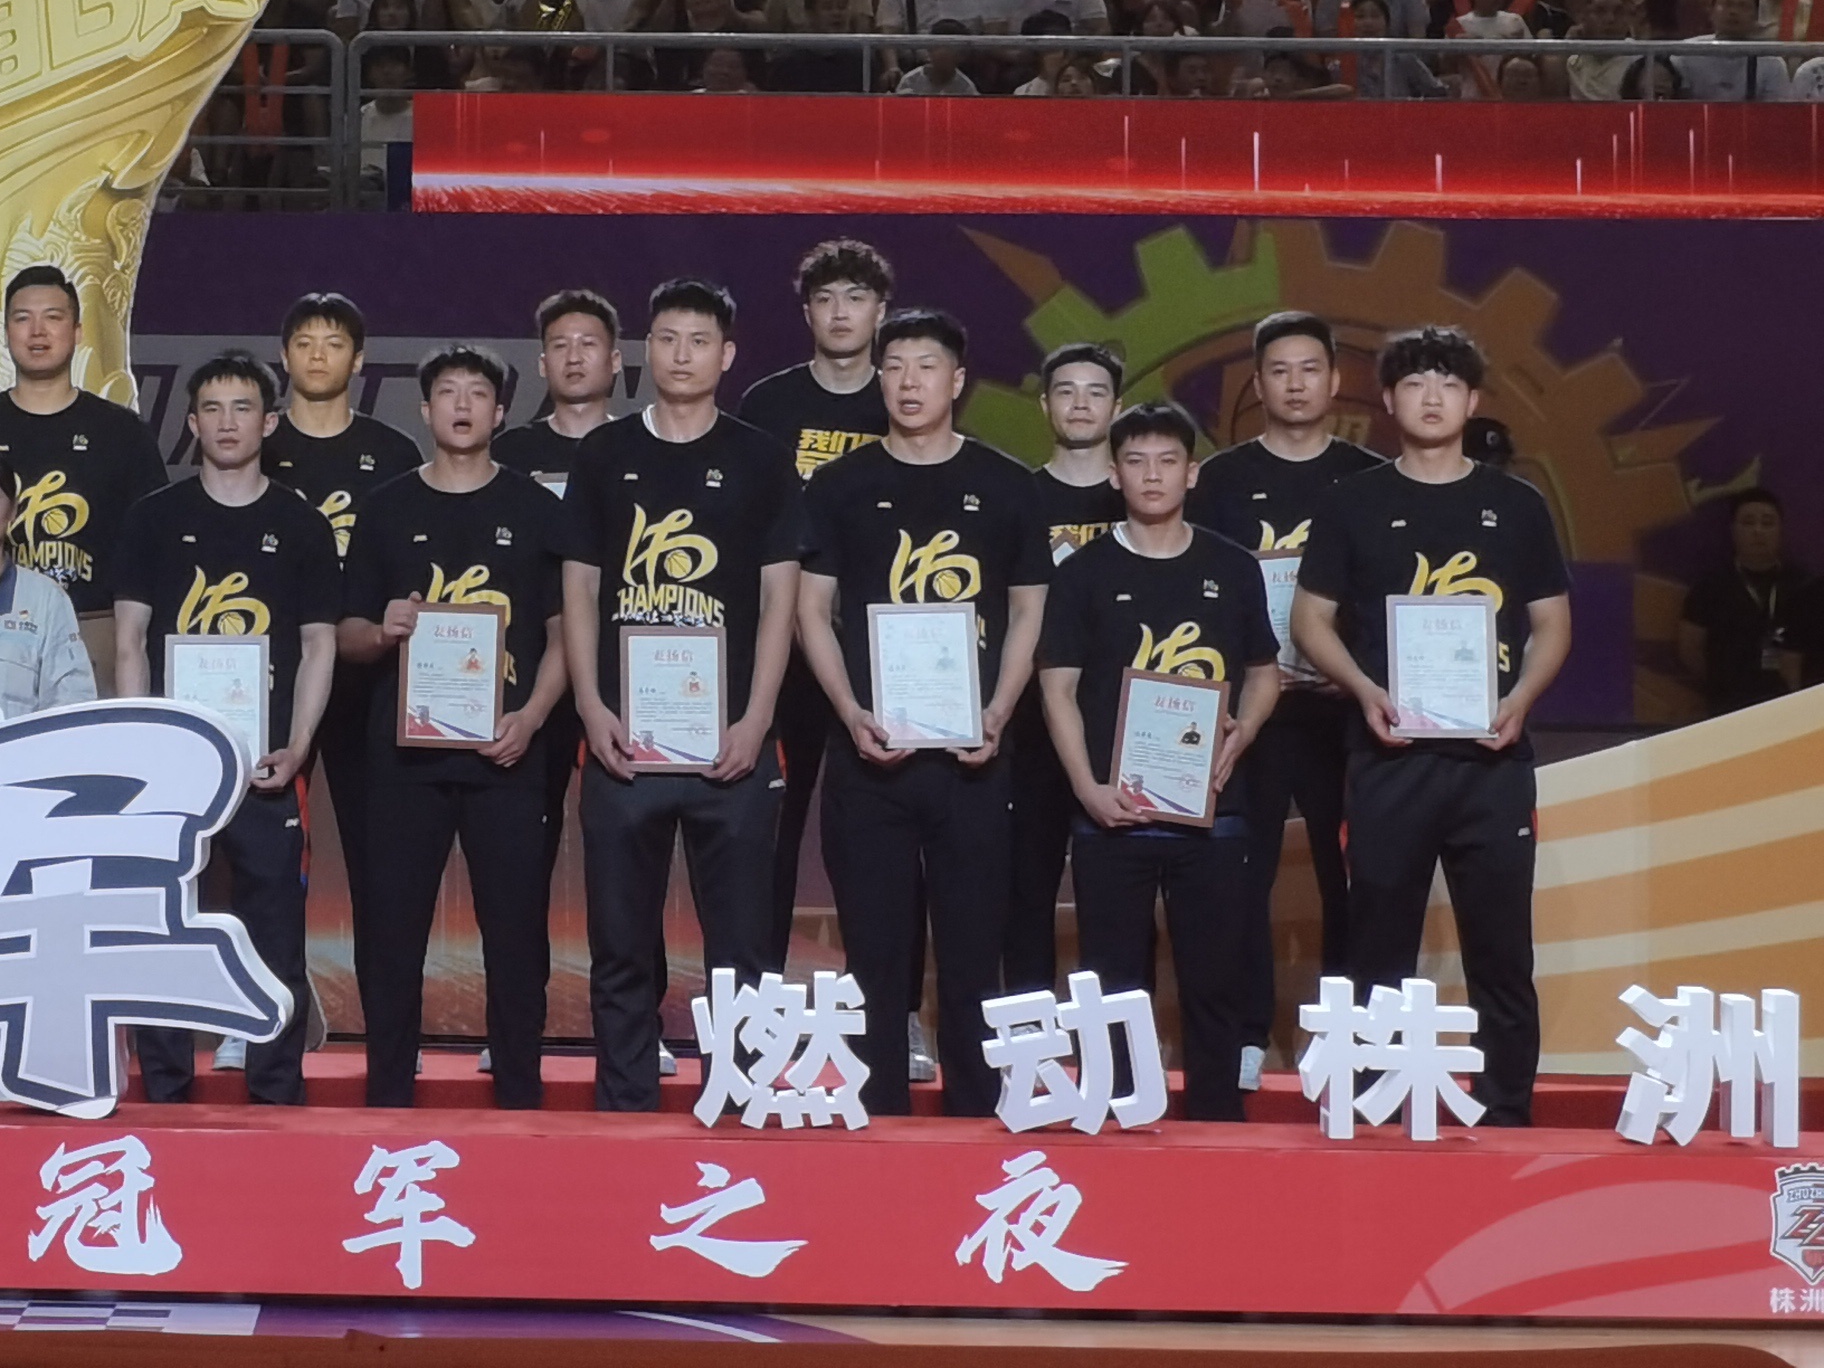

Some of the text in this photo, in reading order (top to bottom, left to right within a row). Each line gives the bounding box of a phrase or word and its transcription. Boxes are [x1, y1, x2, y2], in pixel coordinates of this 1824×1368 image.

[15, 541, 93, 582] AMPIONS
[692, 967, 1801, 1148] 燃动株洲
